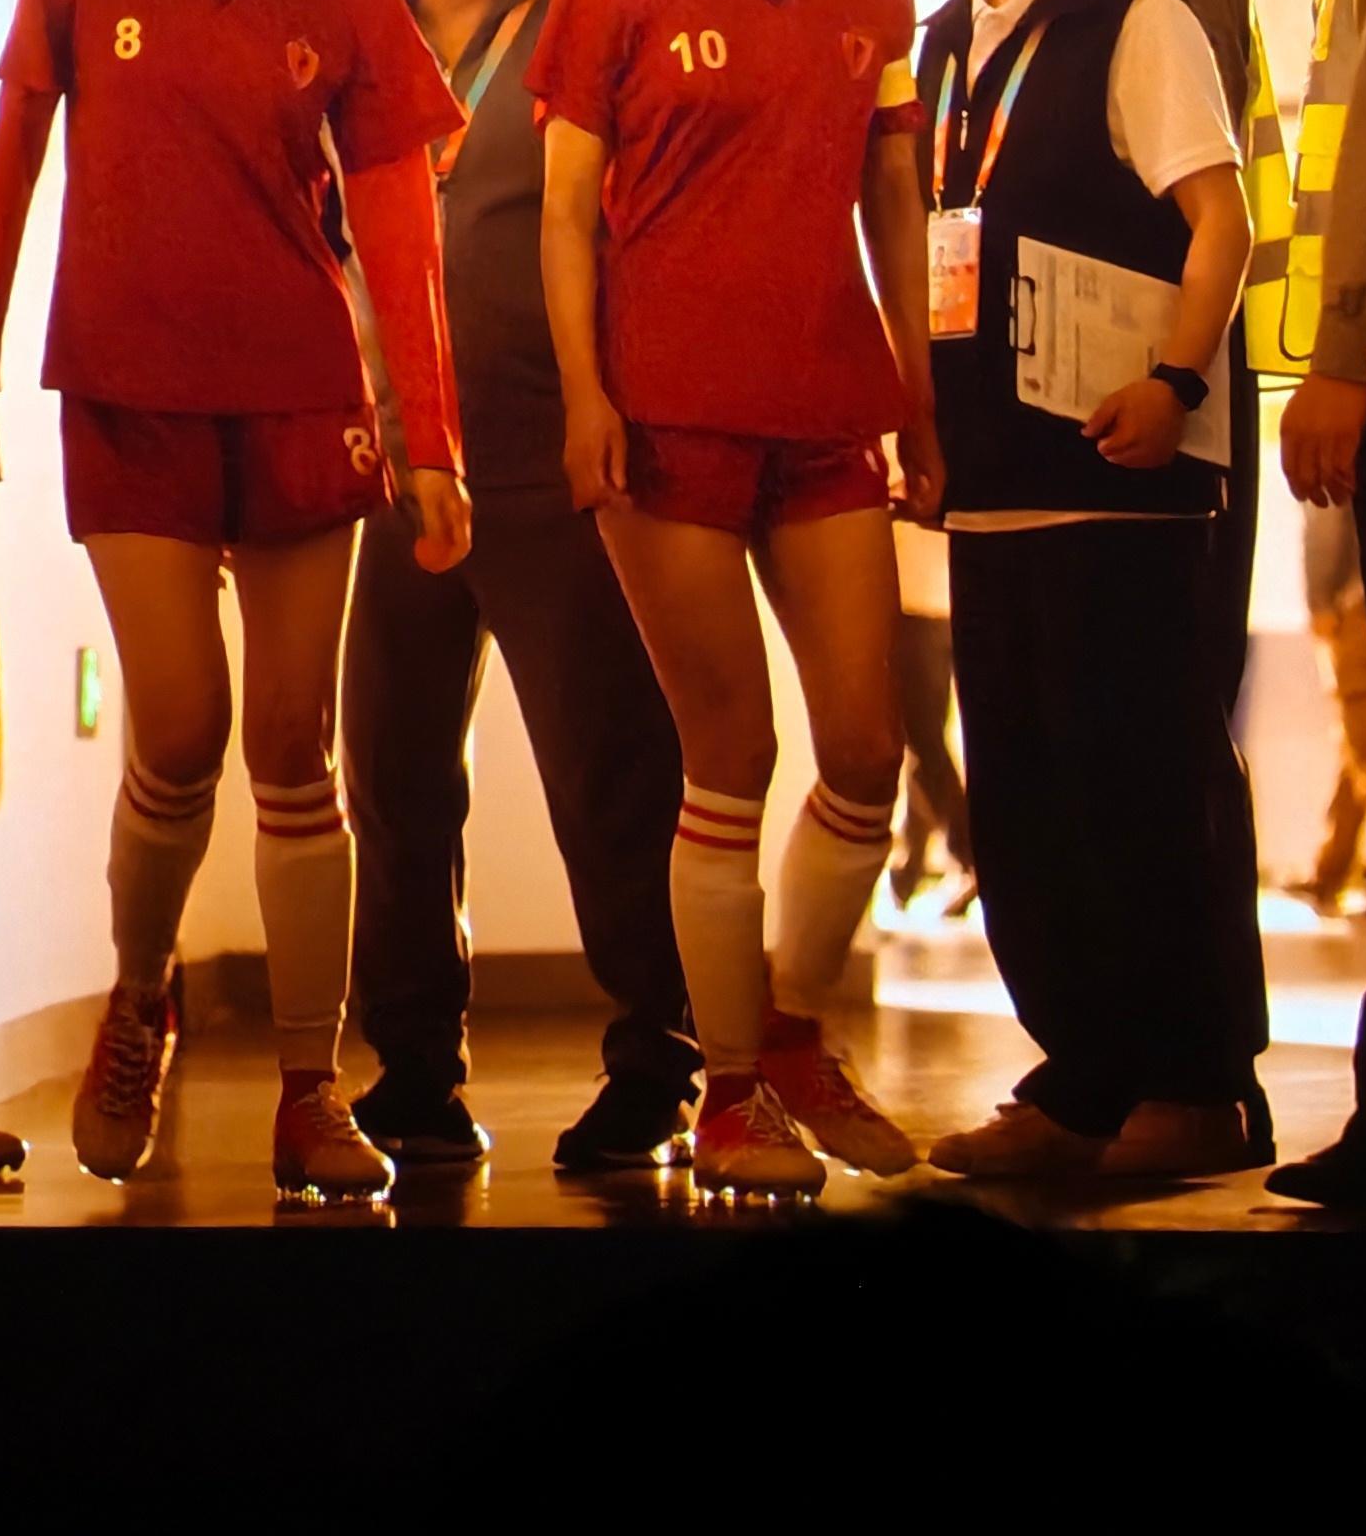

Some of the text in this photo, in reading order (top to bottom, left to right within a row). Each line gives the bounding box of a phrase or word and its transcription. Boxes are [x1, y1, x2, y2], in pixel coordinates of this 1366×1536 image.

[114, 17, 141, 60] 8
[669, 29, 727, 73] 10
[343, 427, 377, 476] 8
